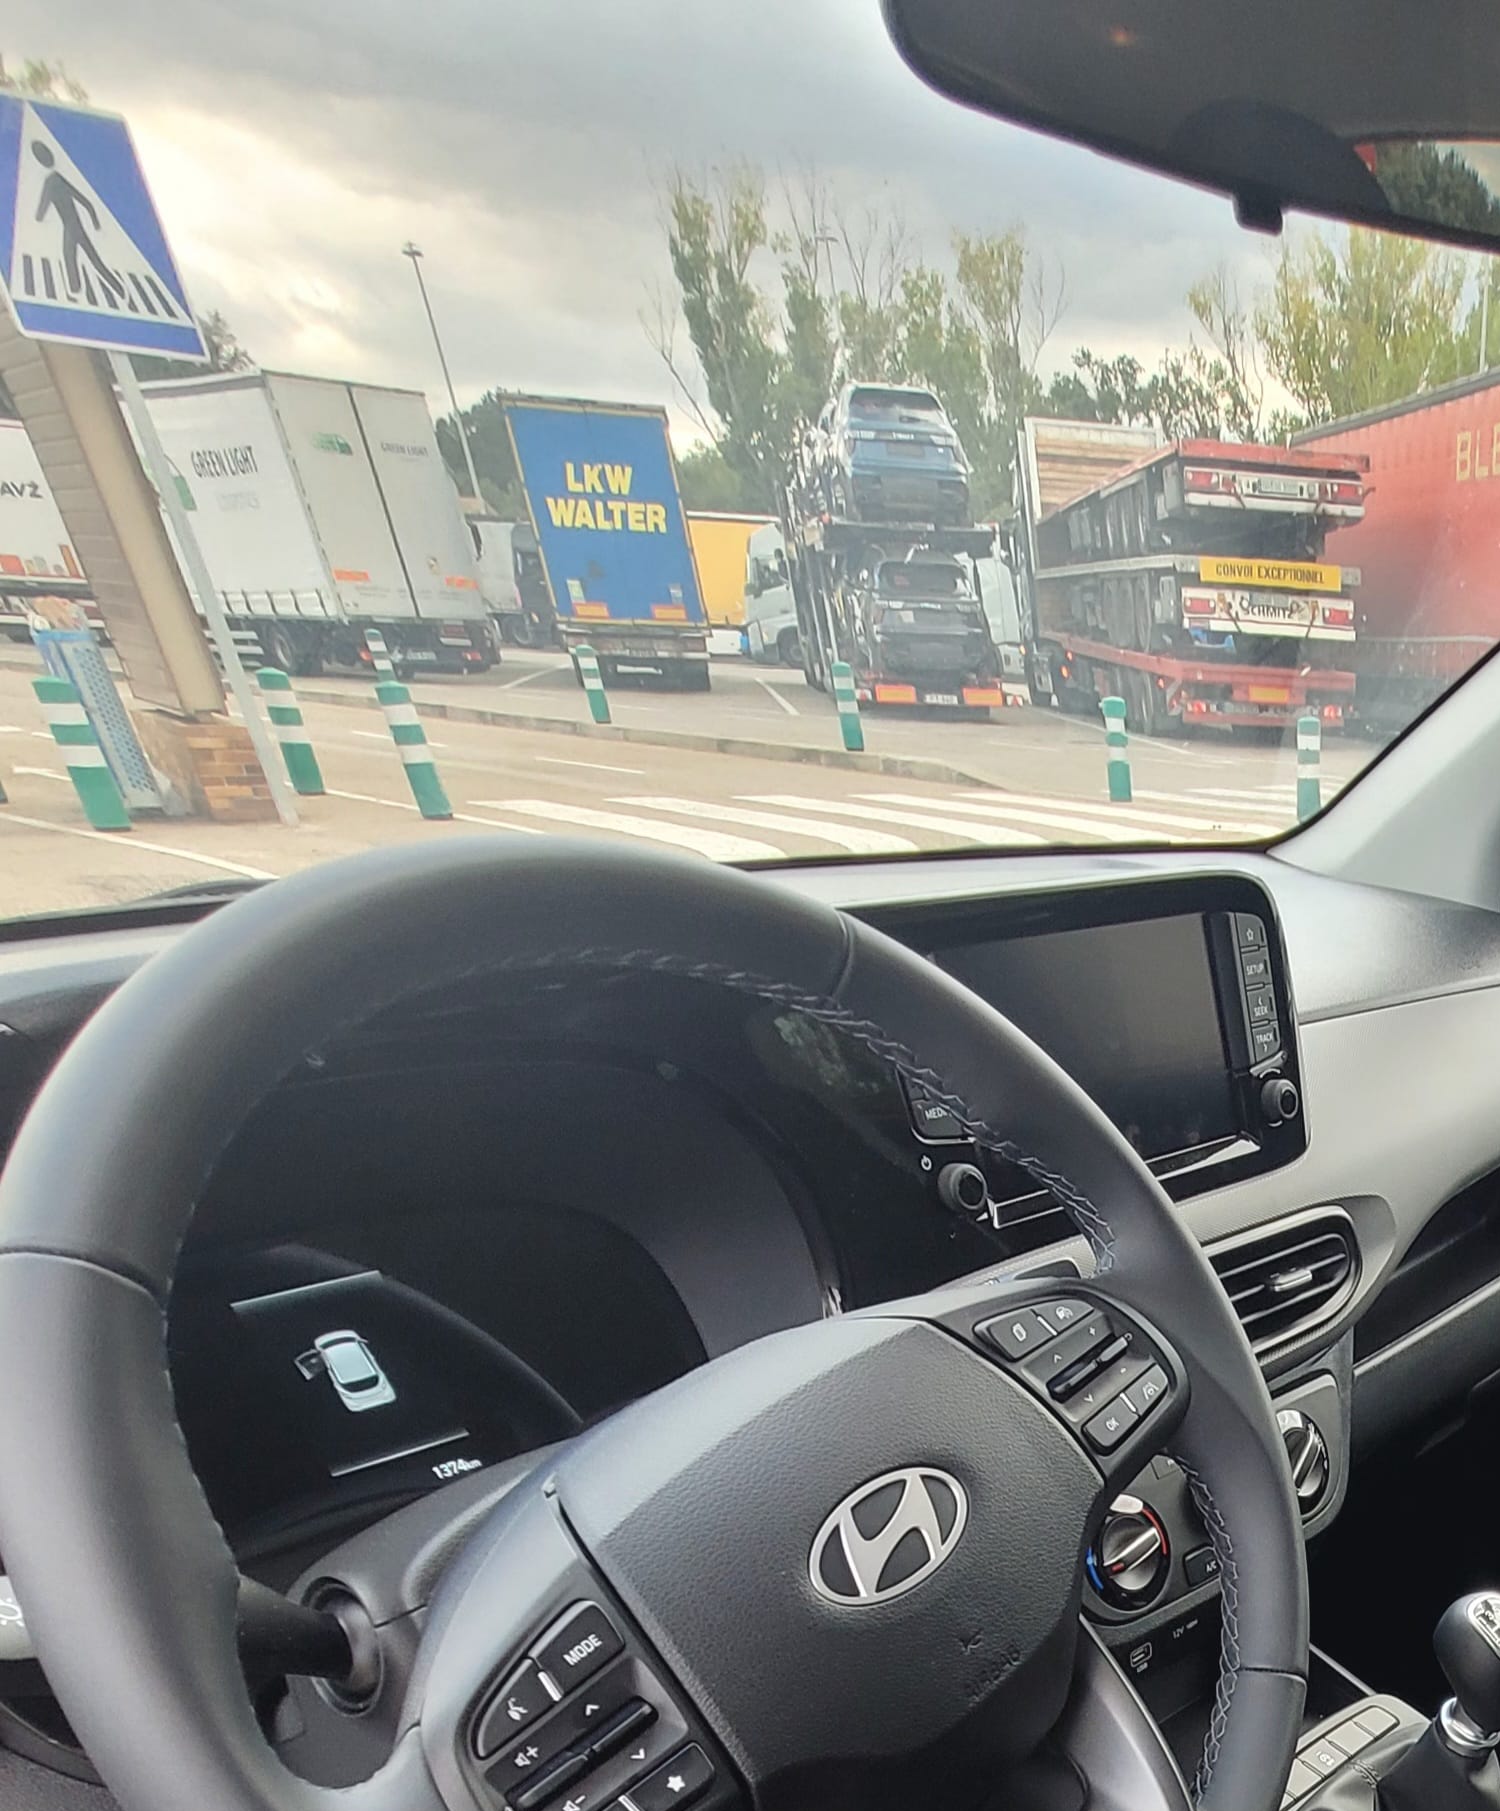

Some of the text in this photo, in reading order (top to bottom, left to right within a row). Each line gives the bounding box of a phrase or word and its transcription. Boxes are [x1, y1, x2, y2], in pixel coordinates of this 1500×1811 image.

[191, 445, 259, 478] GREEN LIGHT
[565, 462, 632, 495] LKW
[546, 497, 668, 534] WALTER
[1215, 563, 1325, 585] CONVOI EXCEPTIONNEL
[1246, 963, 1264, 976] SETUP
[1254, 1005, 1269, 1018] SEEK
[1255, 1032, 1274, 1045] TRACK
[1105, 1417, 1120, 1432] OK
[562, 1633, 603, 1667] MODE
